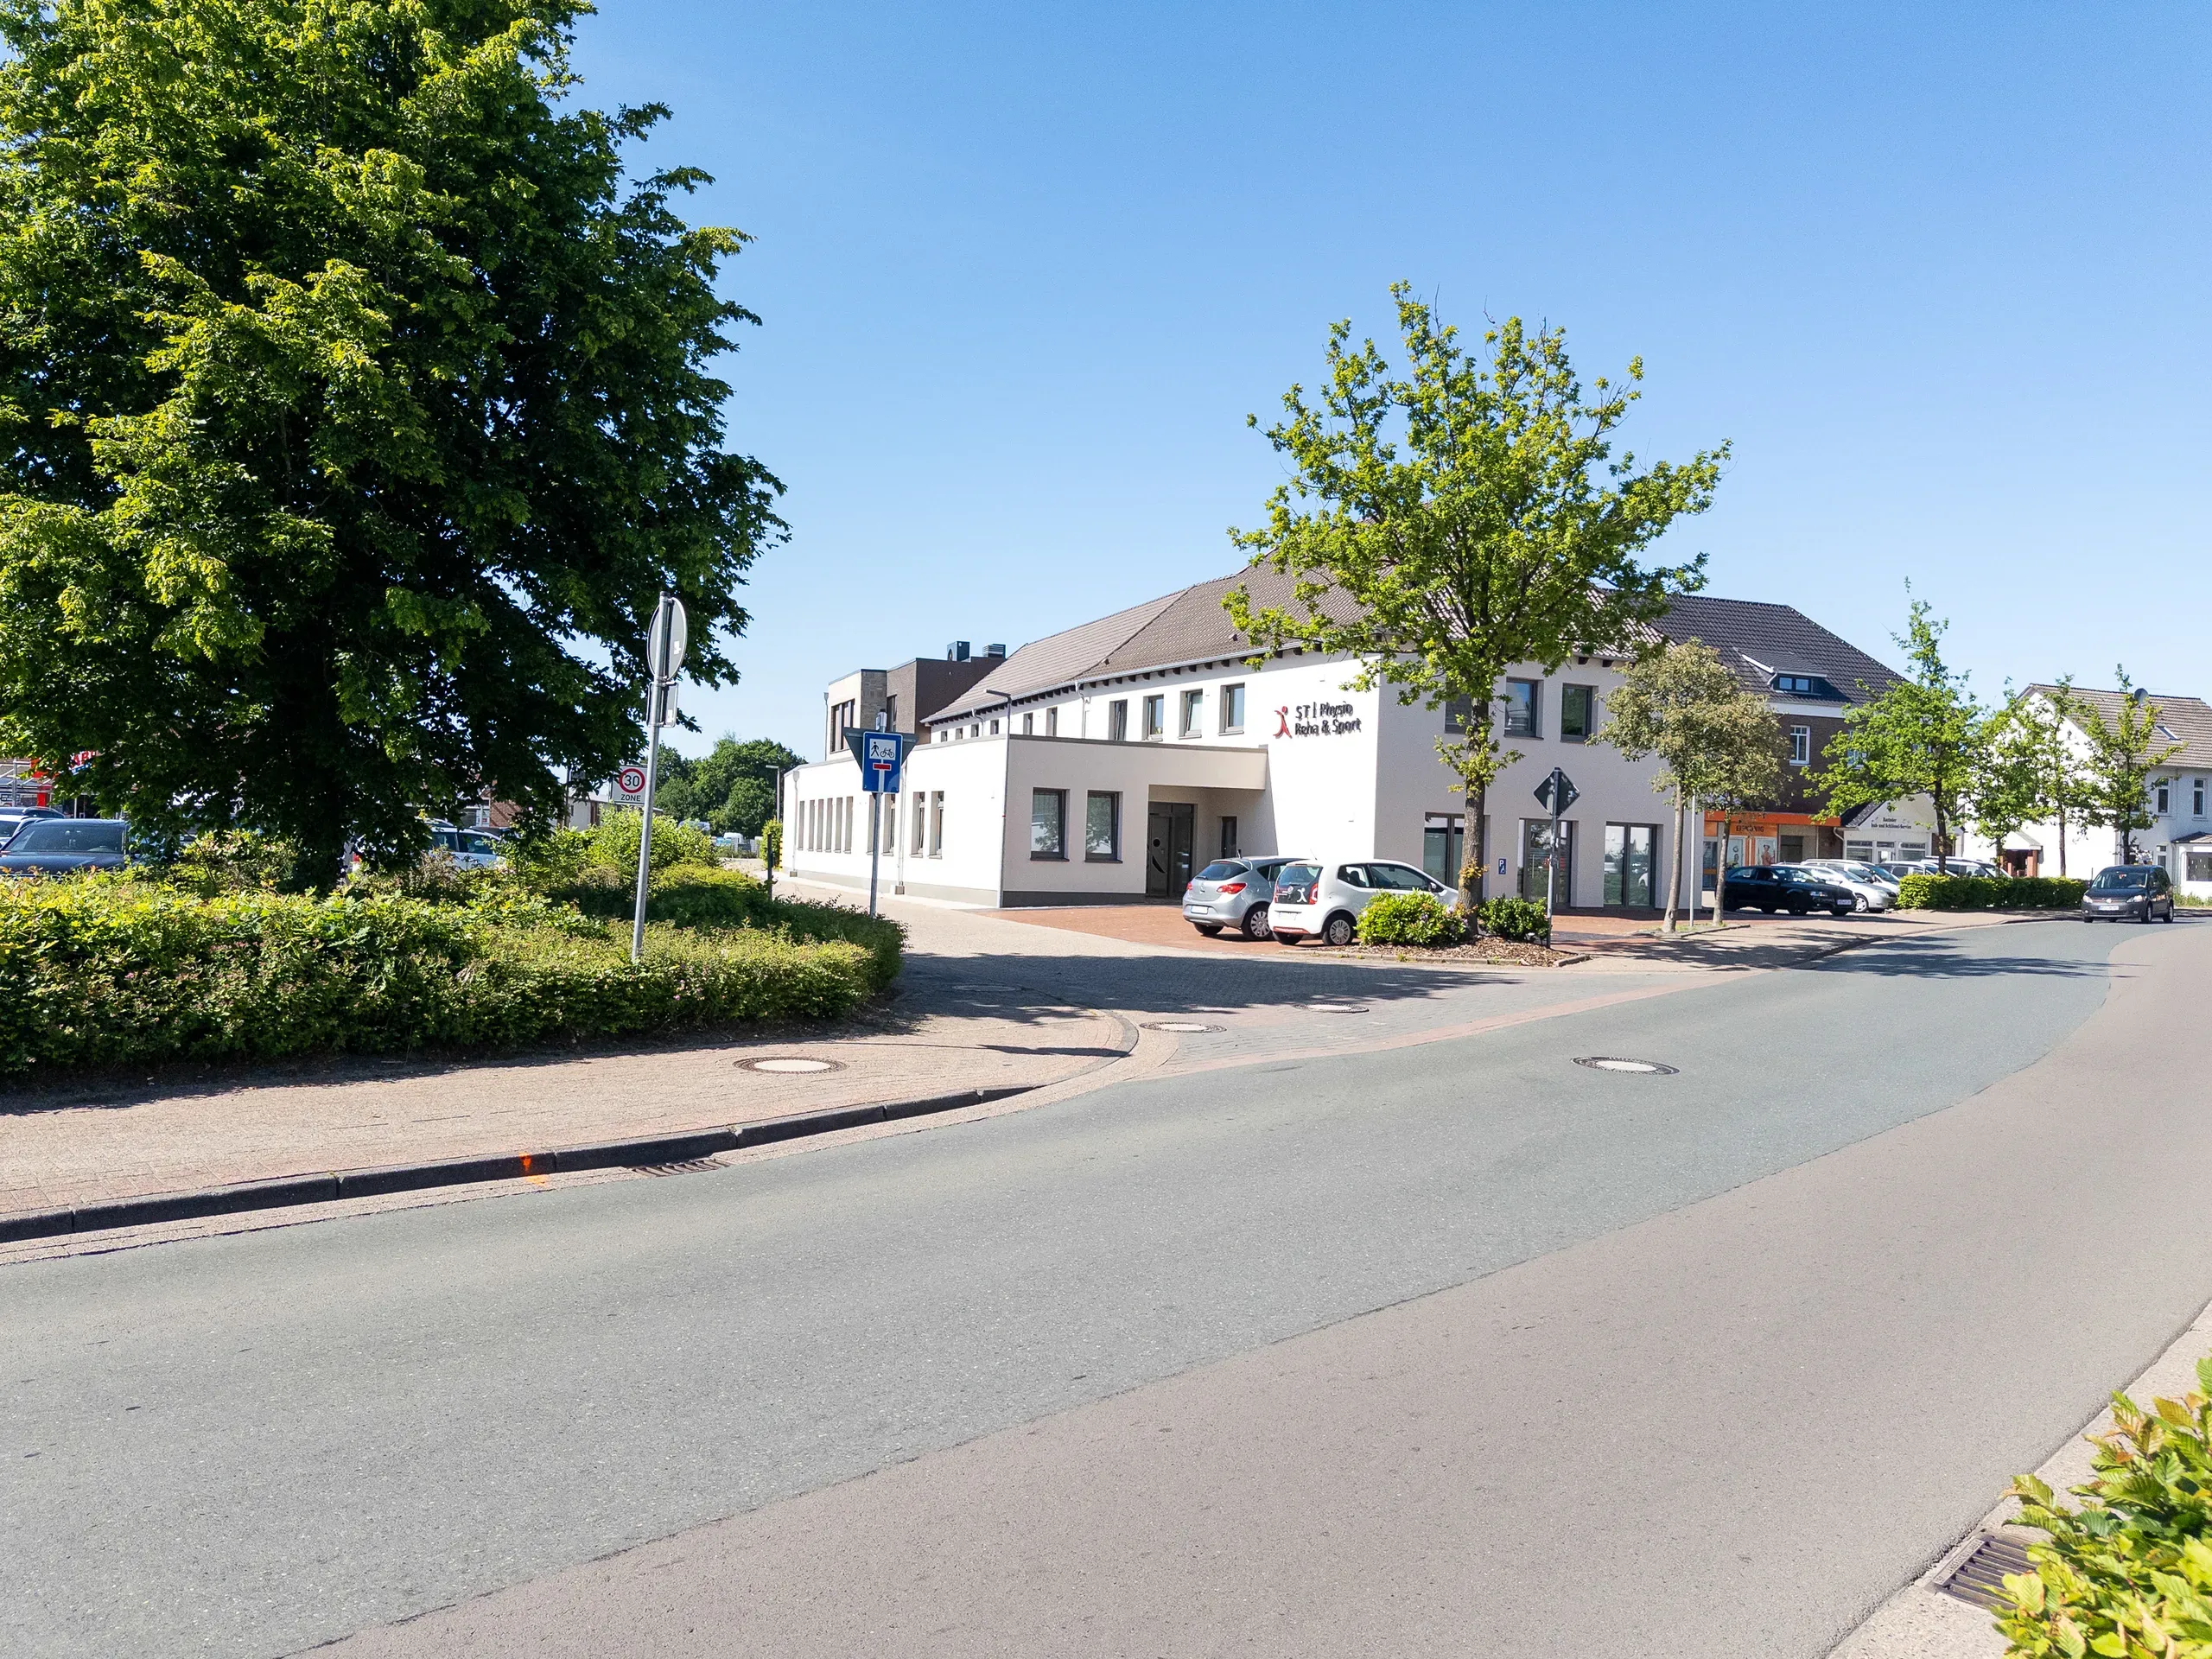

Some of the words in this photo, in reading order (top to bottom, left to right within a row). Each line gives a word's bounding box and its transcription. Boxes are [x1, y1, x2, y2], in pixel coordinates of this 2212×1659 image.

[1295, 705, 1311, 721] ST
[1319, 702, 1353, 717] Physio
[1295, 721, 1319, 736] Reha
[1321, 720, 1331, 734] &
[1332, 718, 1362, 736] Sport
[625, 775, 640, 787] 30
